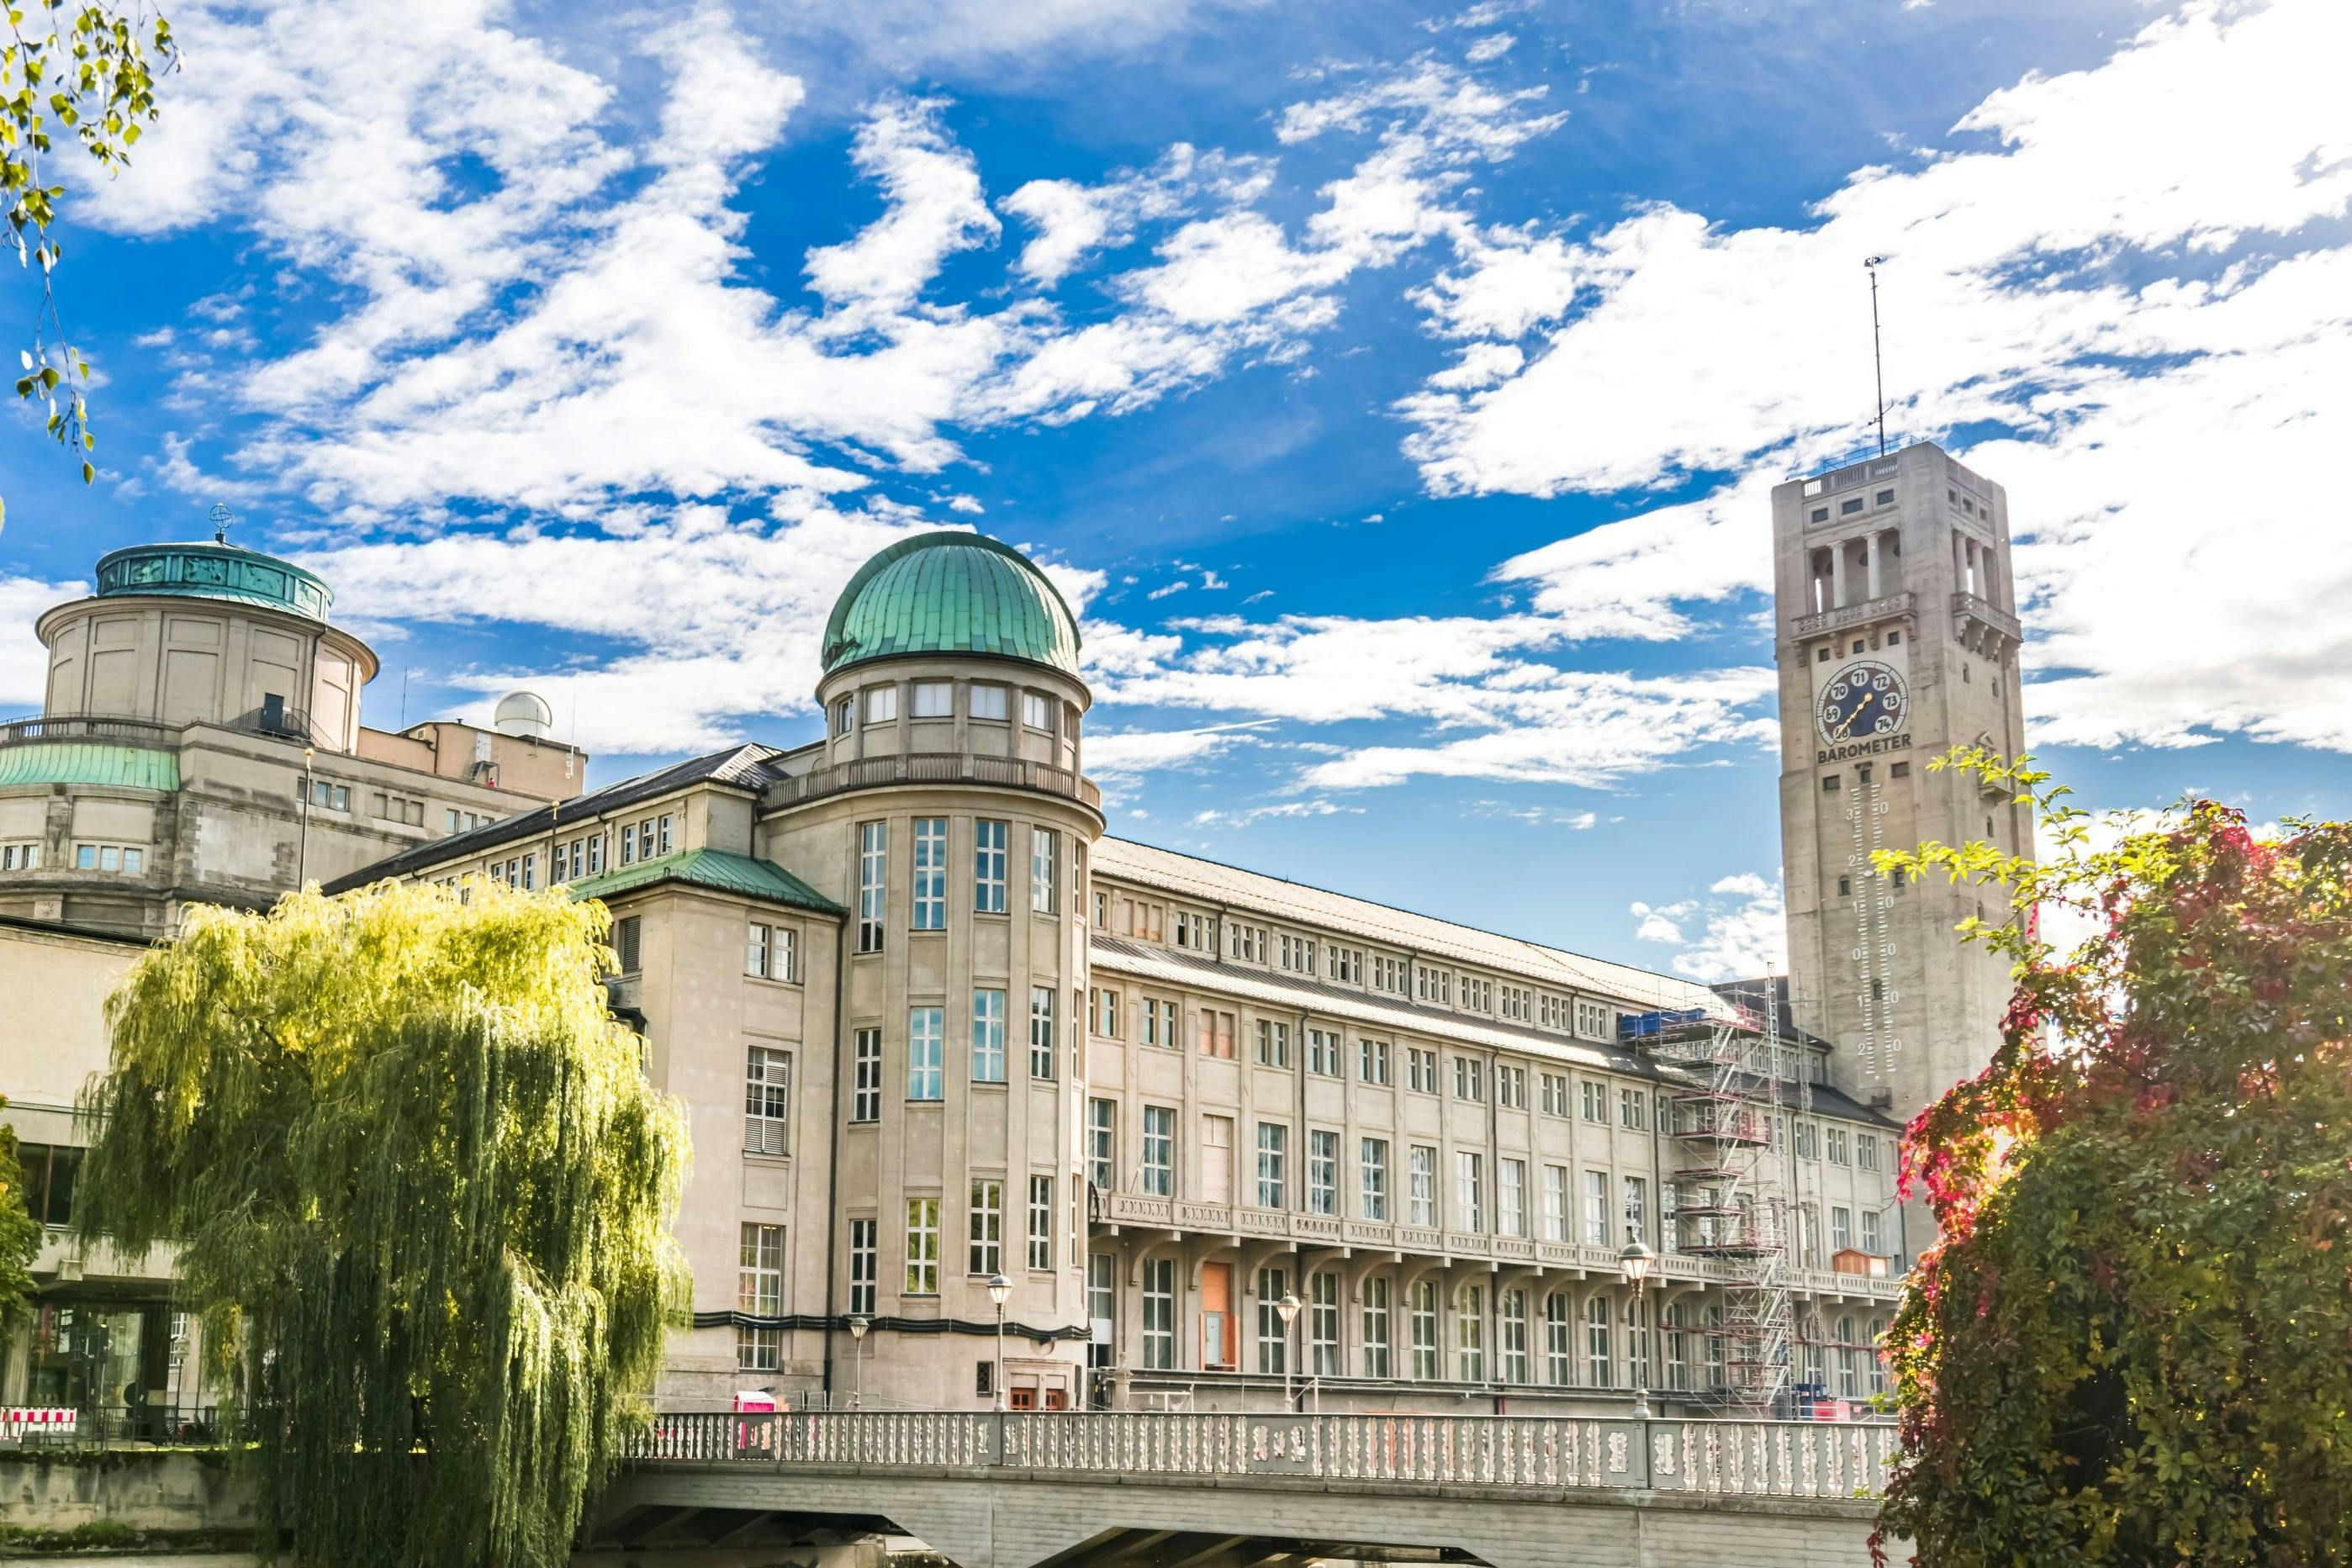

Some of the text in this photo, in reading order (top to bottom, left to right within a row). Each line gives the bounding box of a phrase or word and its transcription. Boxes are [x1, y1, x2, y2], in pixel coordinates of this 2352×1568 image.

[1853, 672, 1865, 684] 71
[1875, 676, 1888, 689] 72
[1833, 685, 1845, 698] 70
[1885, 695, 1897, 707] 73
[1826, 708, 1838, 721] 69
[1877, 720, 1891, 731] 74
[1817, 733, 1911, 763] BAROMETER
